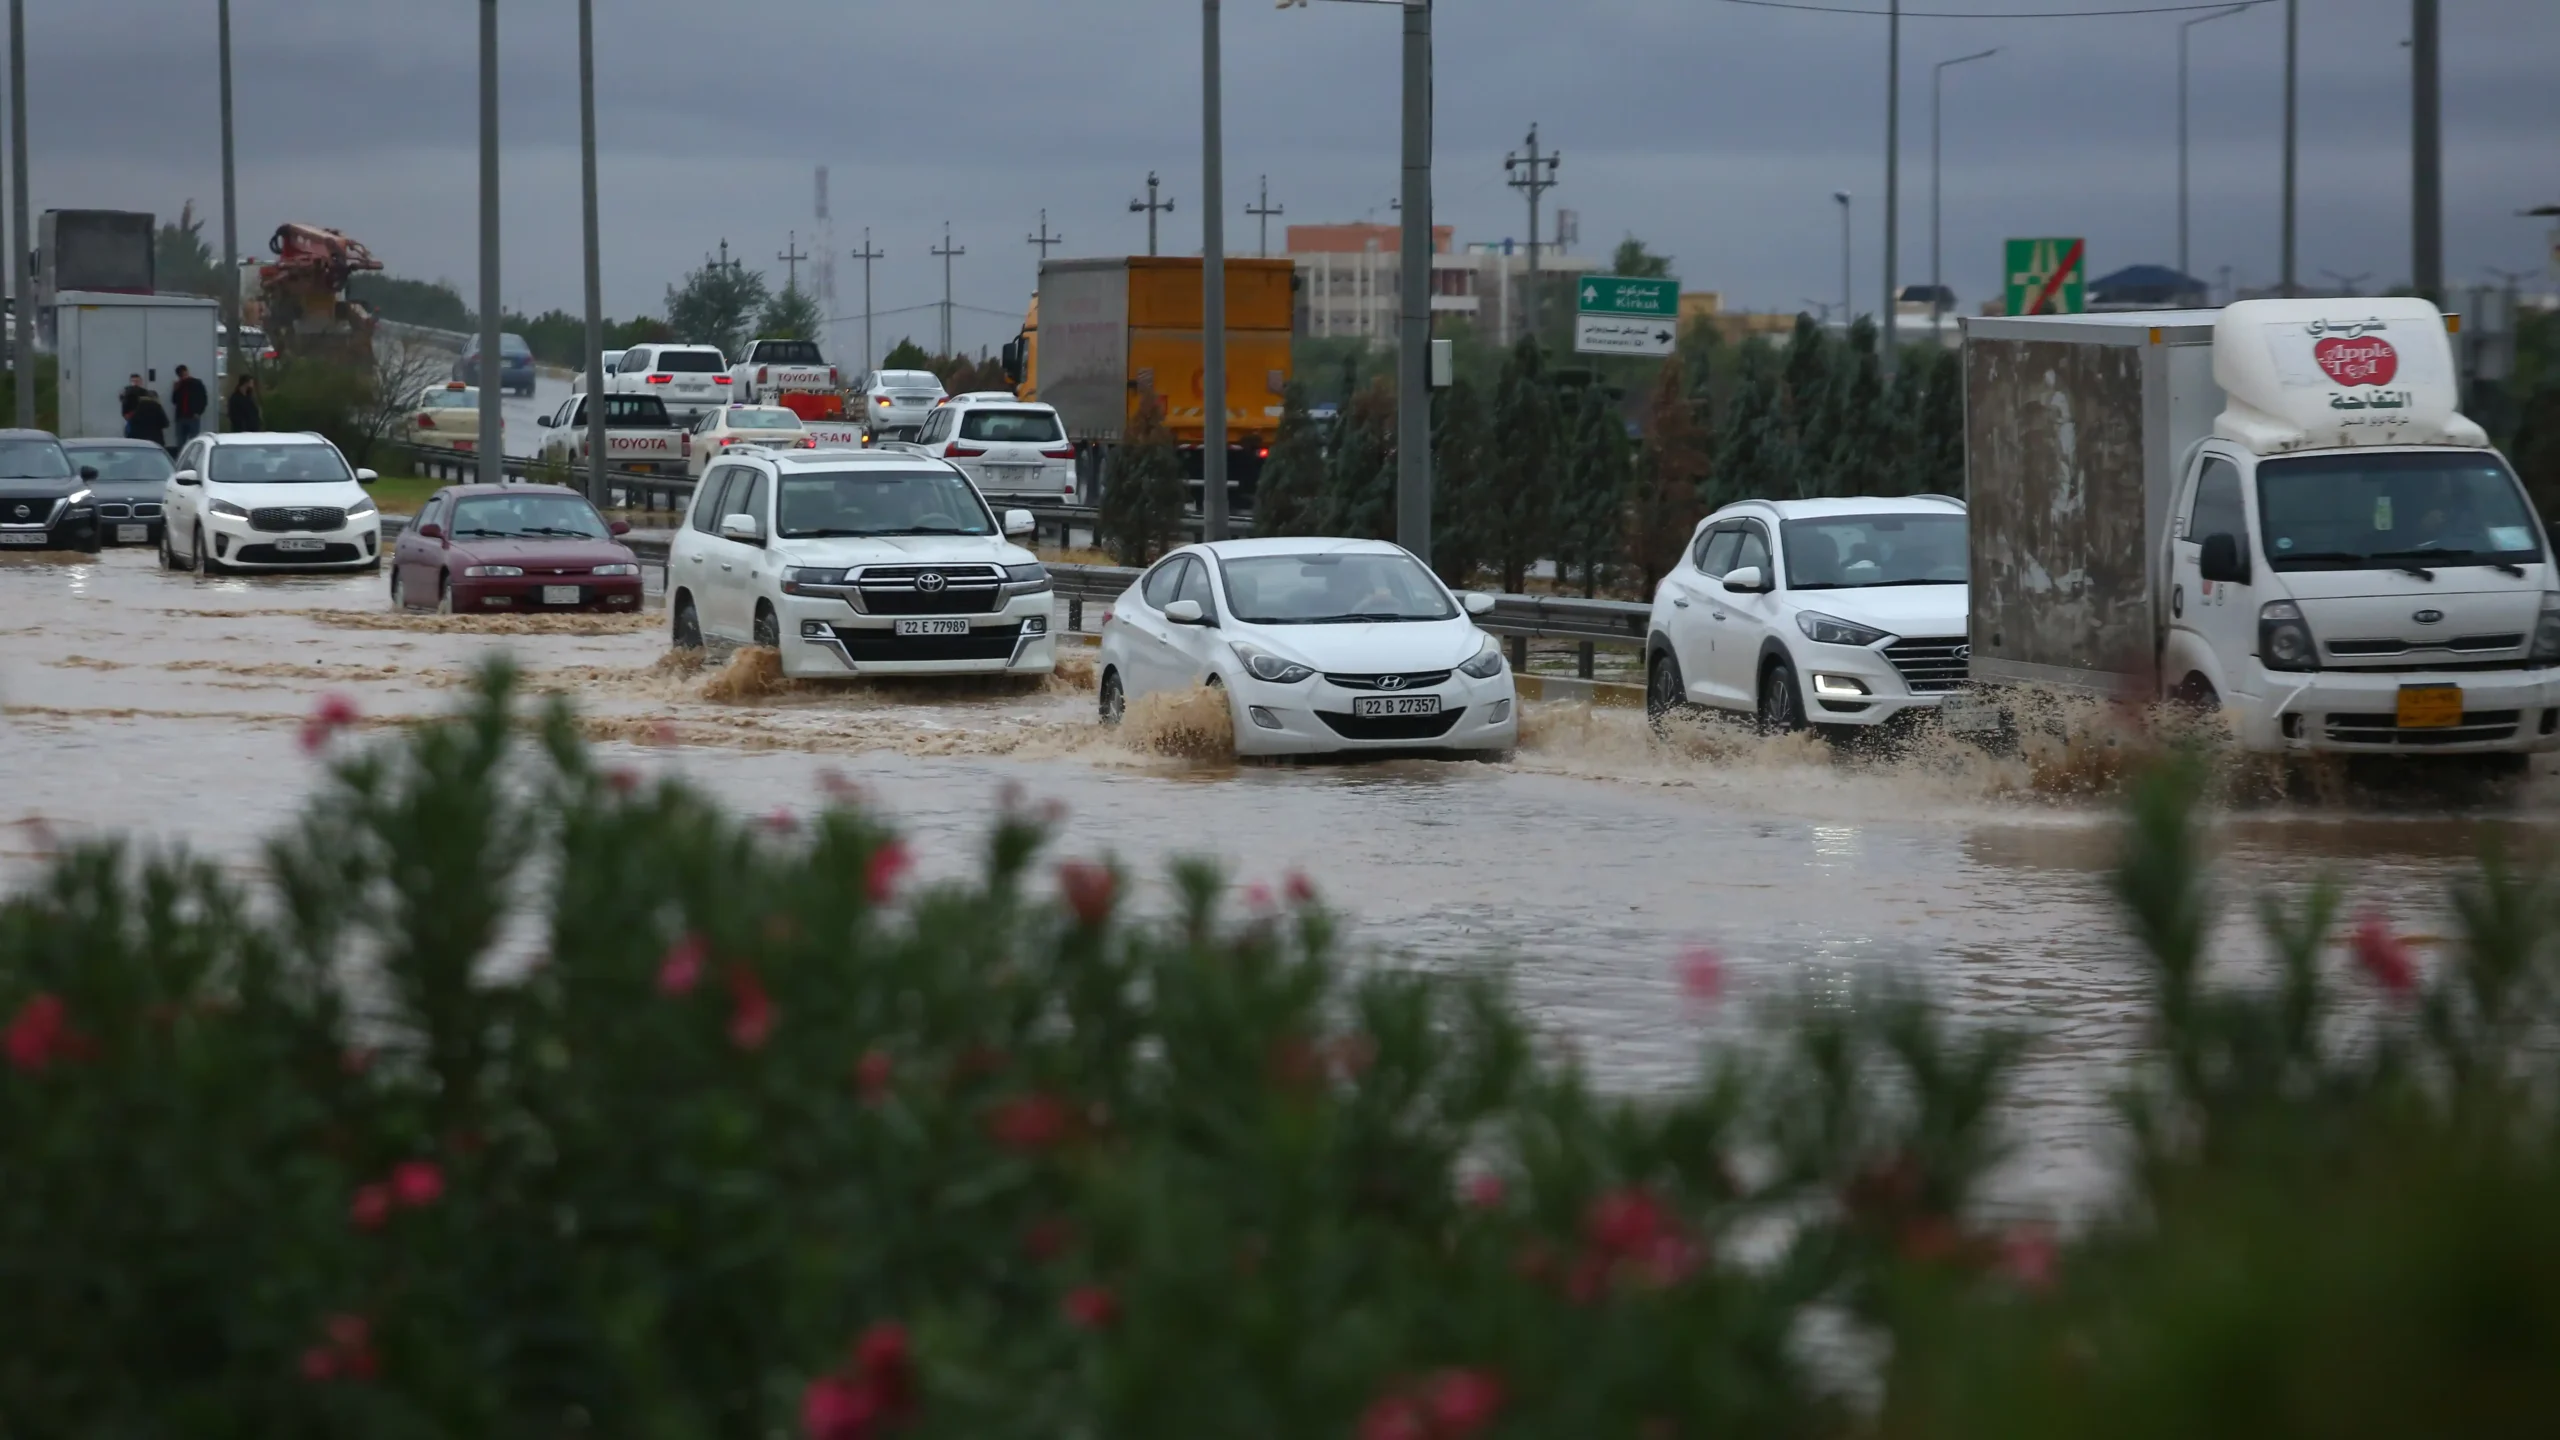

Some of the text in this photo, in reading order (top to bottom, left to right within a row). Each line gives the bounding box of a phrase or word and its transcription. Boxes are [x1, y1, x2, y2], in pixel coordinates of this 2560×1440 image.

[1616, 299, 1659, 310] Kirkuk
[2320, 343, 2393, 362] Apple
[777, 373, 820, 382] TOYOTA
[2328, 389, 2412, 410] التفاحة
[609, 438, 668, 450] TOYOTA
[905, 621, 918, 633] 22
[922, 621, 929, 633] E
[933, 621, 966, 633] 77989
[1366, 700, 1381, 714] 22
[1386, 700, 1394, 713] B
[1399, 699, 1436, 713] 27357
